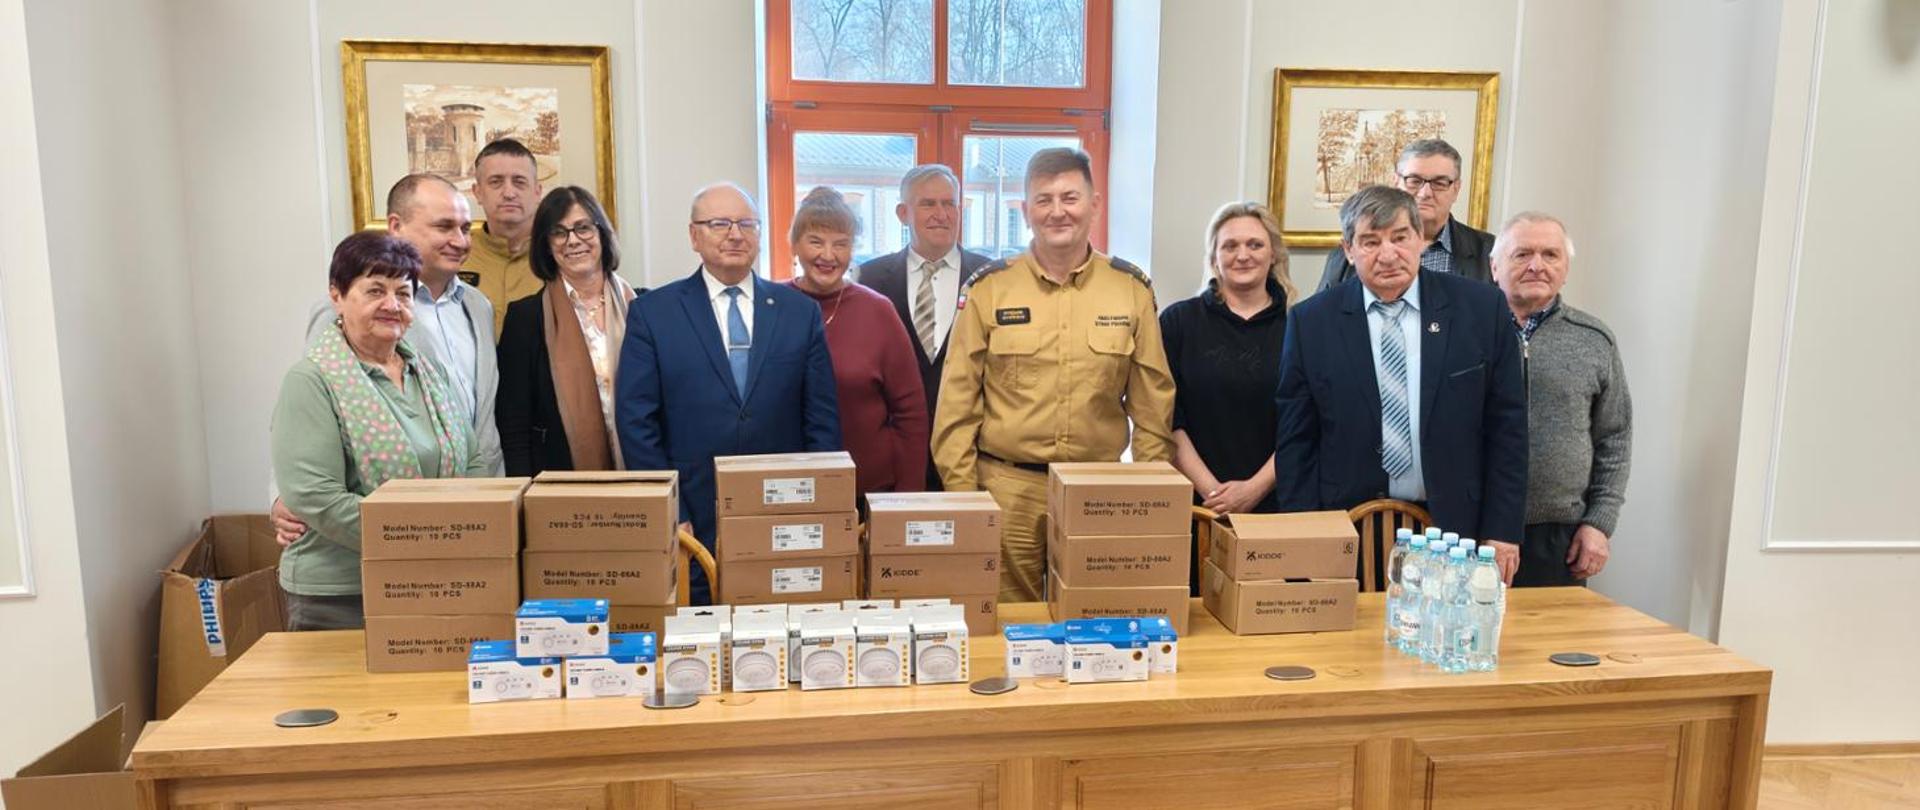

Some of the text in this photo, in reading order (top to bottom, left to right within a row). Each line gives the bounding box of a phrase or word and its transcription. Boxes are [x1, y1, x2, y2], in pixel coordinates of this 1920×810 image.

[383, 523, 409, 532] Model
[443, 532, 462, 540] PCS
[384, 582, 410, 590] Model
[443, 590, 462, 598] PCS
[446, 646, 465, 654] PCS
